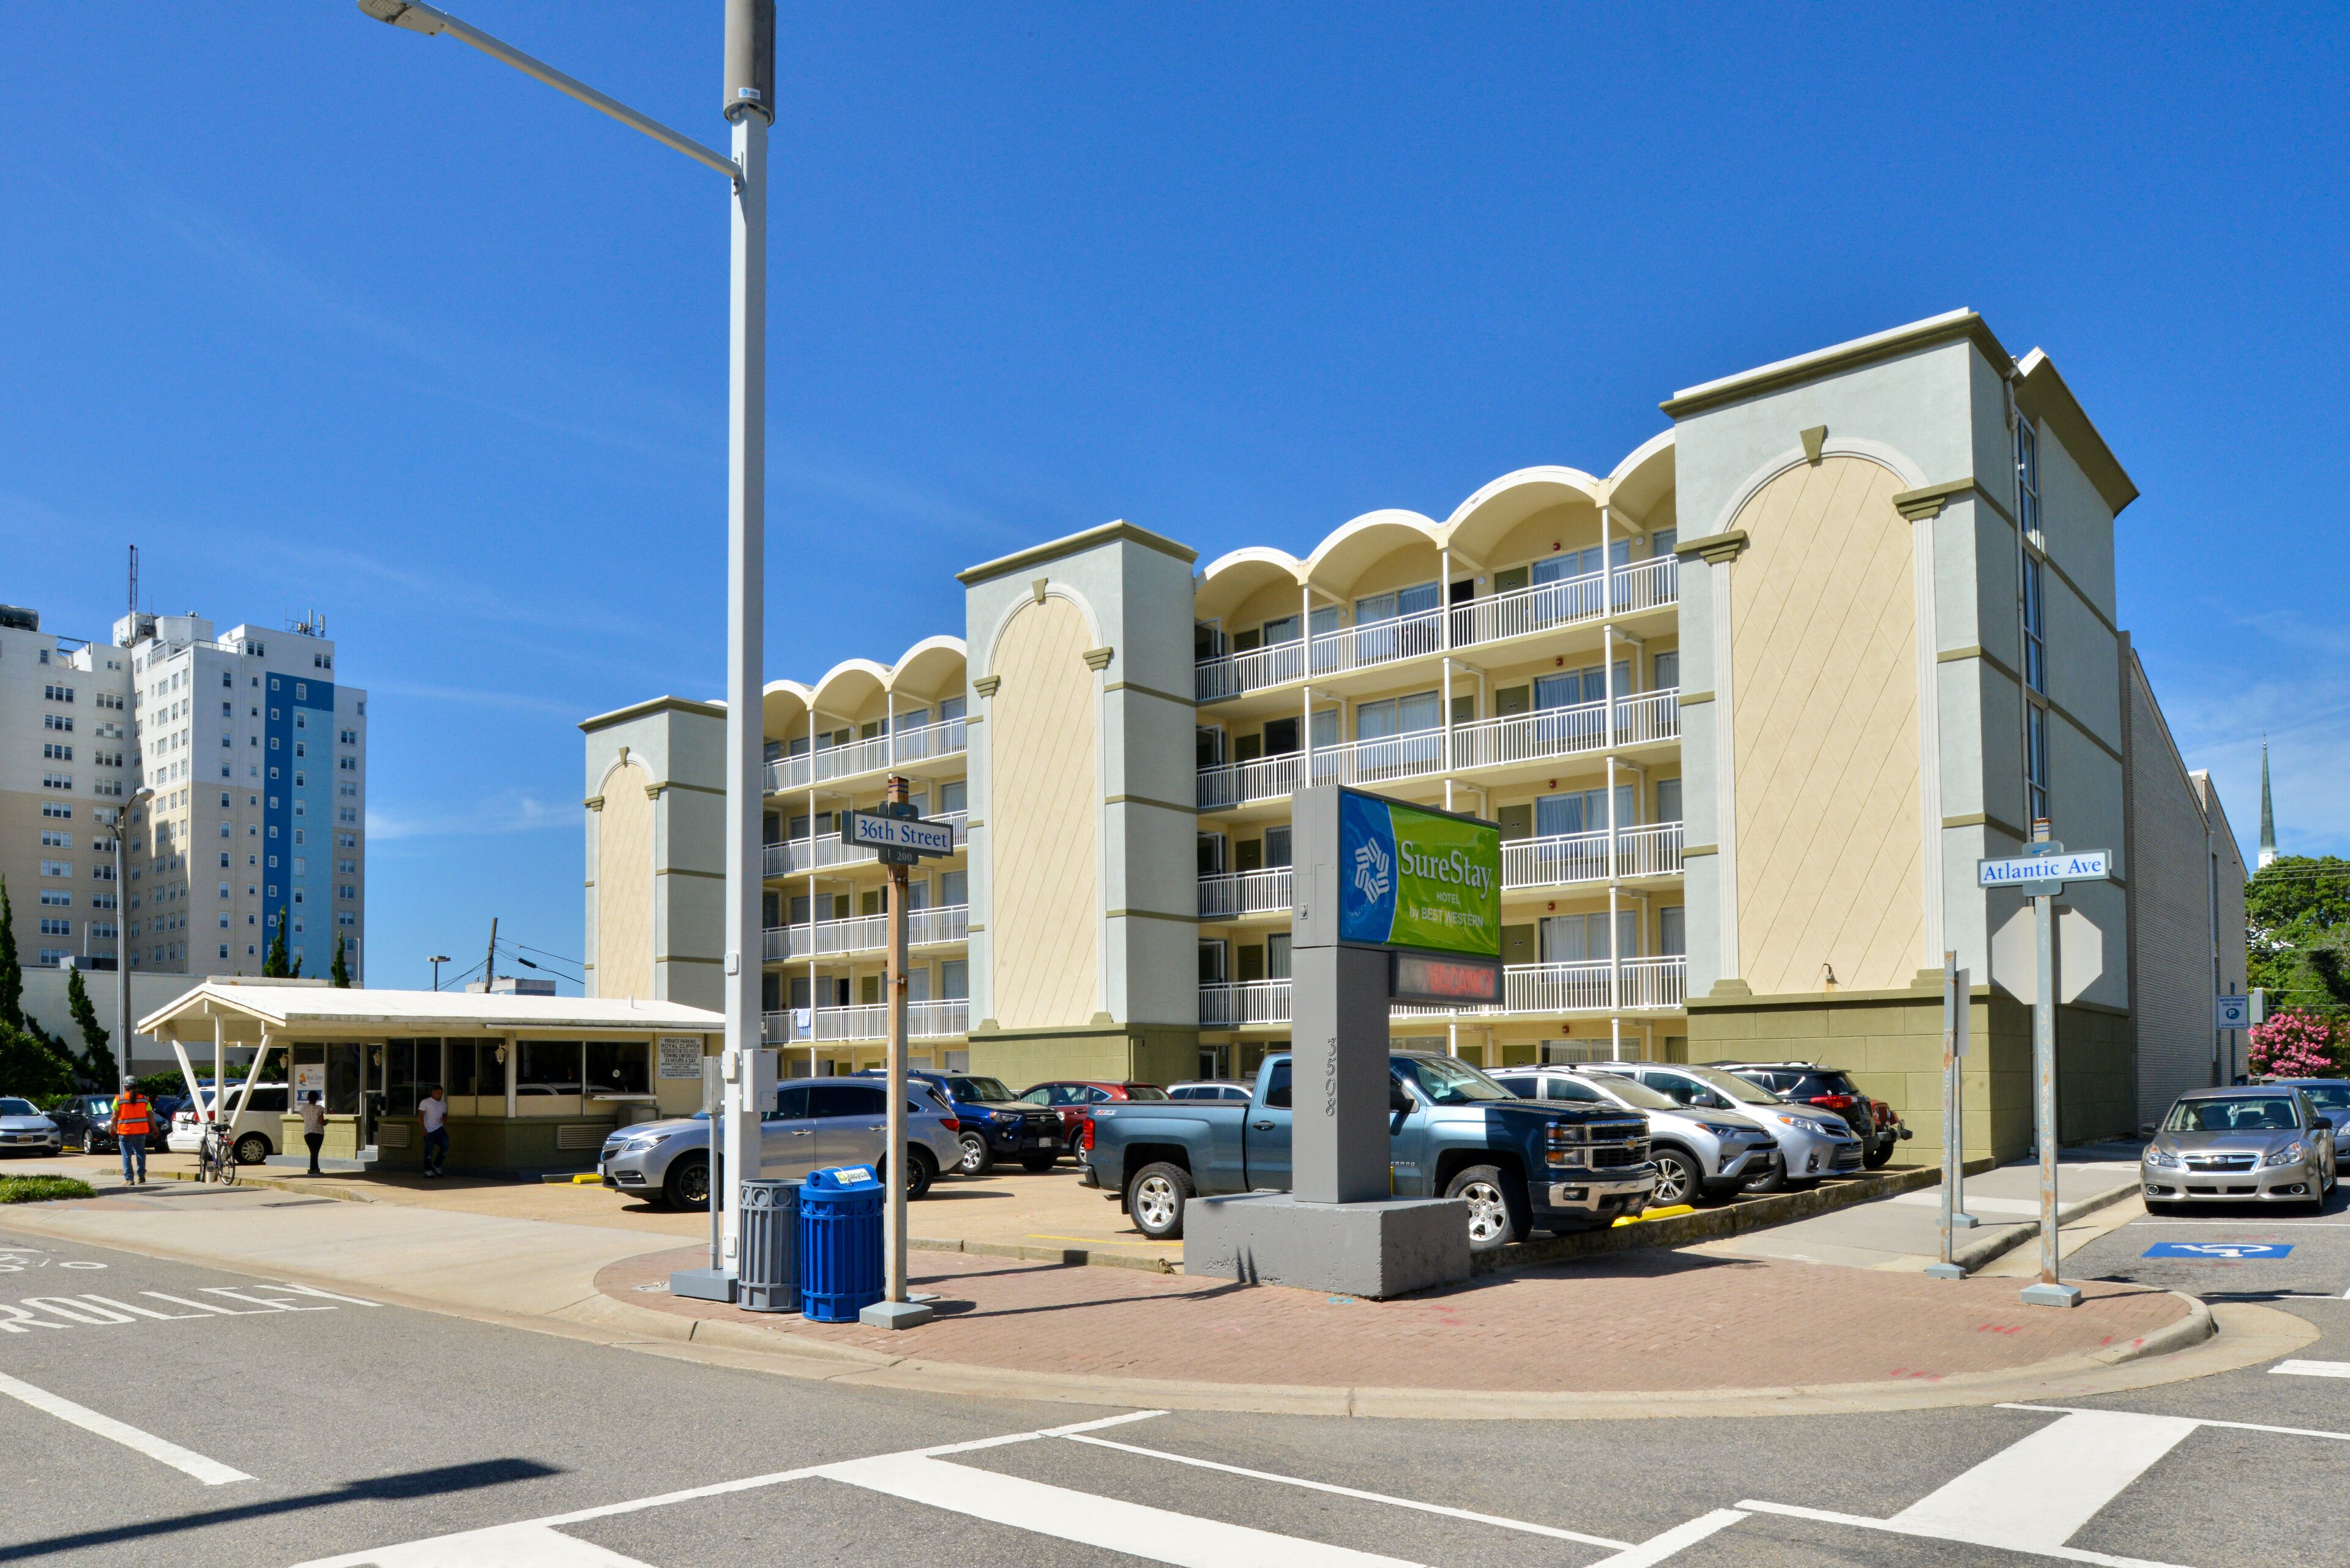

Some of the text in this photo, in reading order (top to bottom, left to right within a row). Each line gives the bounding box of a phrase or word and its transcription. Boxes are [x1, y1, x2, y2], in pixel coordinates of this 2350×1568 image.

[859, 819, 947, 848] 36th Street
[897, 851, 912, 862] 200
[1400, 840, 1493, 900] SureStay
[1983, 858, 2102, 881] Atlantic Ave
[1436, 891, 1460, 905] HOTEL
[1409, 905, 1483, 927] by BEST WESTERN
[1326, 1037, 1337, 1117] 3508
